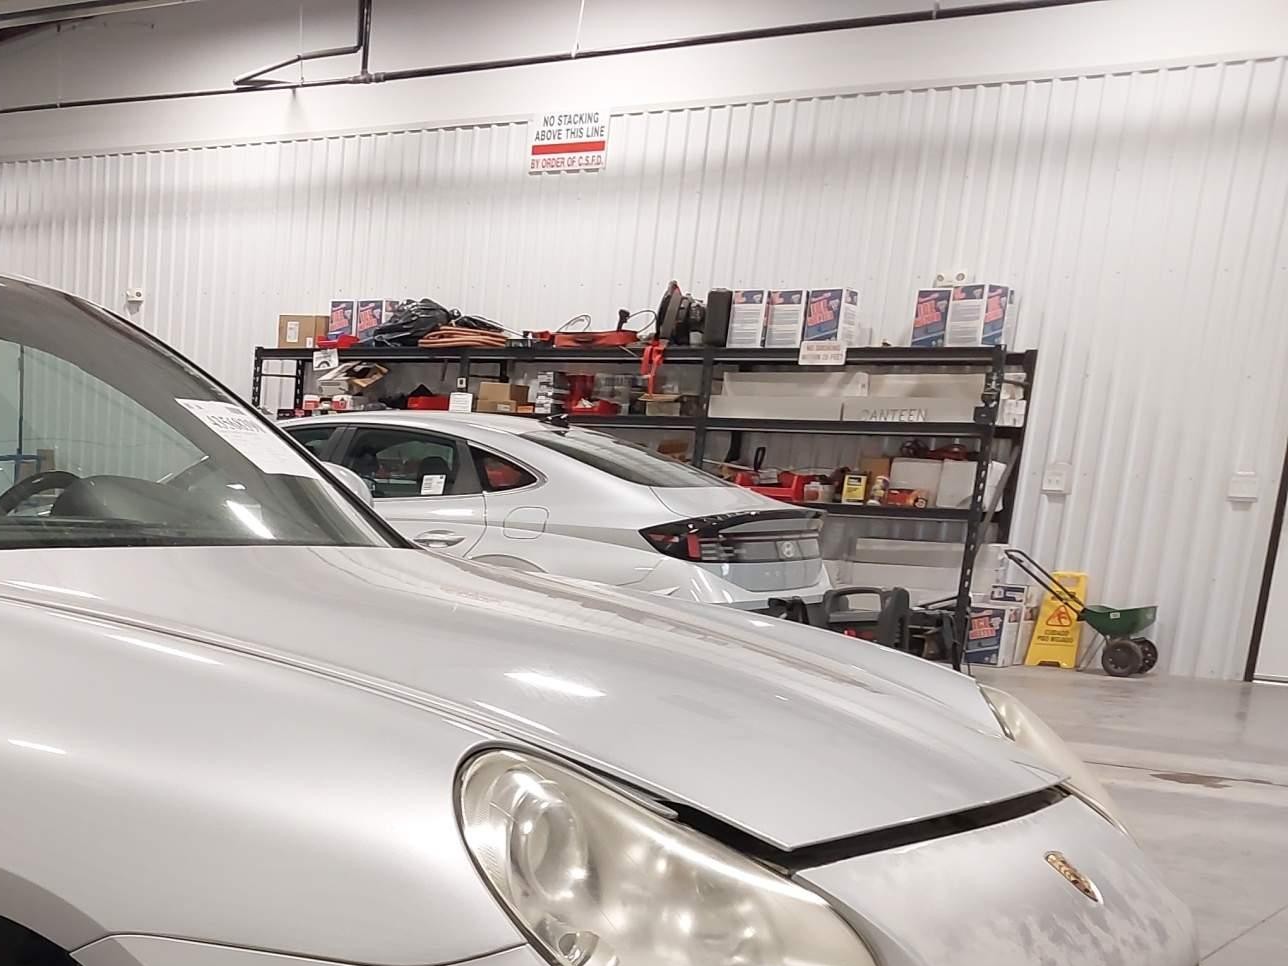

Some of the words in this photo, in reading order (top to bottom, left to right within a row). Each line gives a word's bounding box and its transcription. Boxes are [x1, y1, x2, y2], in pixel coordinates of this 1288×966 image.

[543, 115, 555, 127] NO
[557, 112, 599, 126] STACKING
[535, 129, 562, 142] ABOVE
[565, 127, 583, 139] THIS
[586, 125, 605, 138] LINE
[531, 159, 540, 169] BY
[541, 157, 565, 168] ORDER
[567, 156, 577, 167] OF
